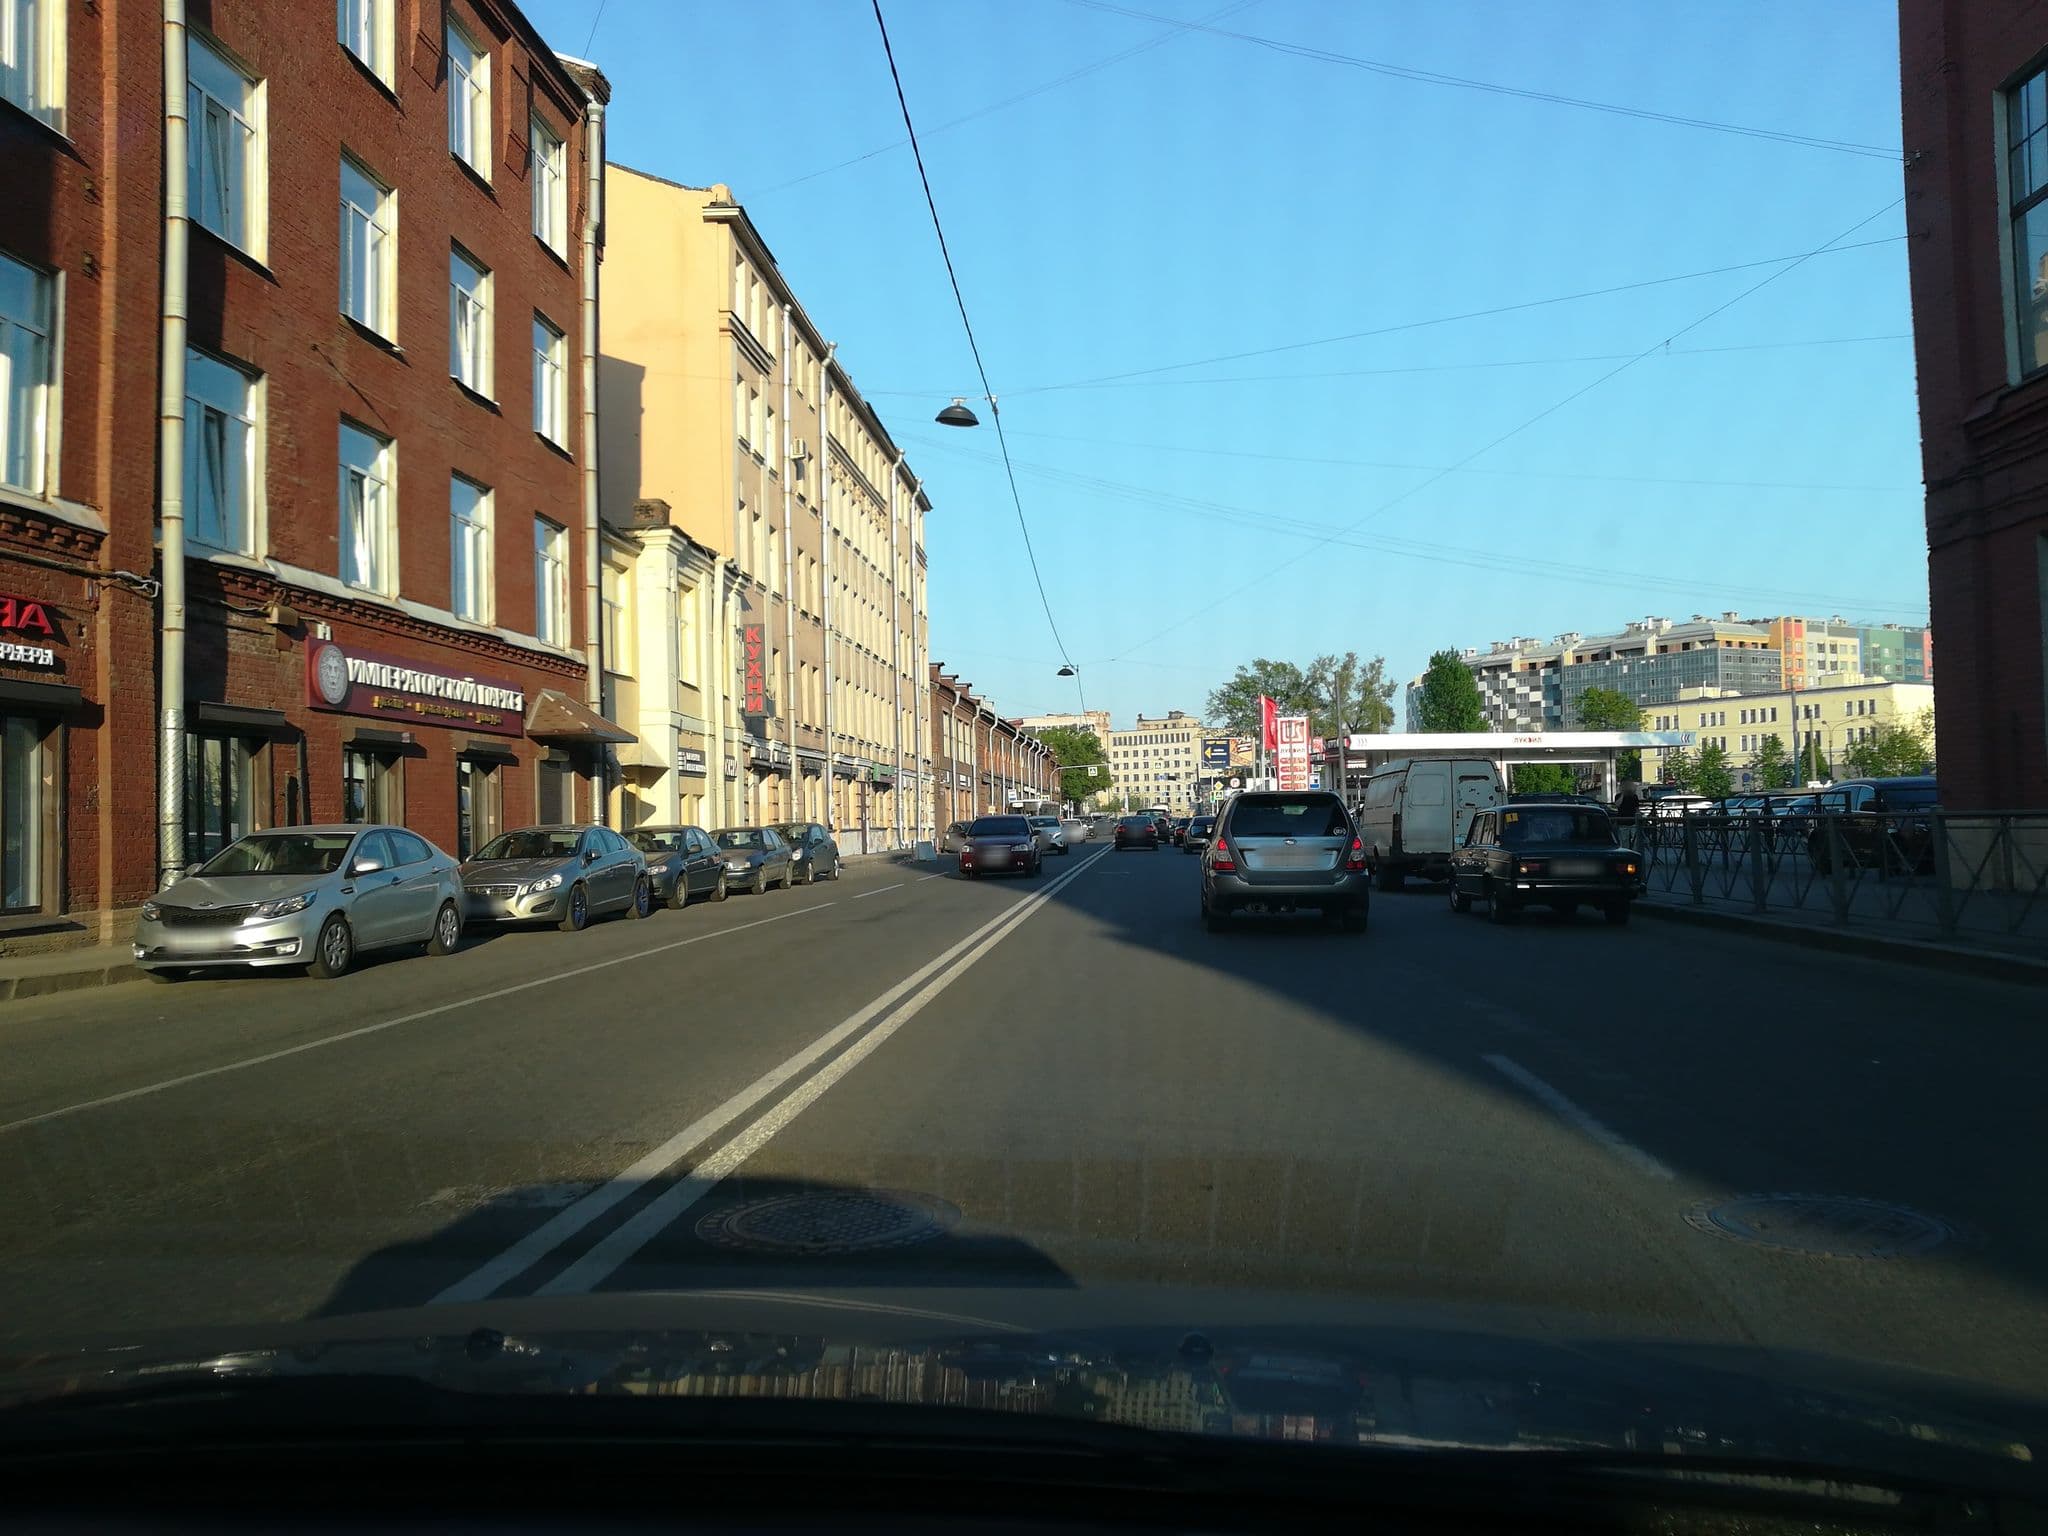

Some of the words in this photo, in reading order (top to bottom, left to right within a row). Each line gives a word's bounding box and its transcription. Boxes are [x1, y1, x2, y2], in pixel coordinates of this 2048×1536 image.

[0, 642, 54, 666] РЬЕРЫ
[746, 626, 763, 713] КУХНИ
[345, 658, 477, 705] ИМПЕРАТОРСКИЙ
